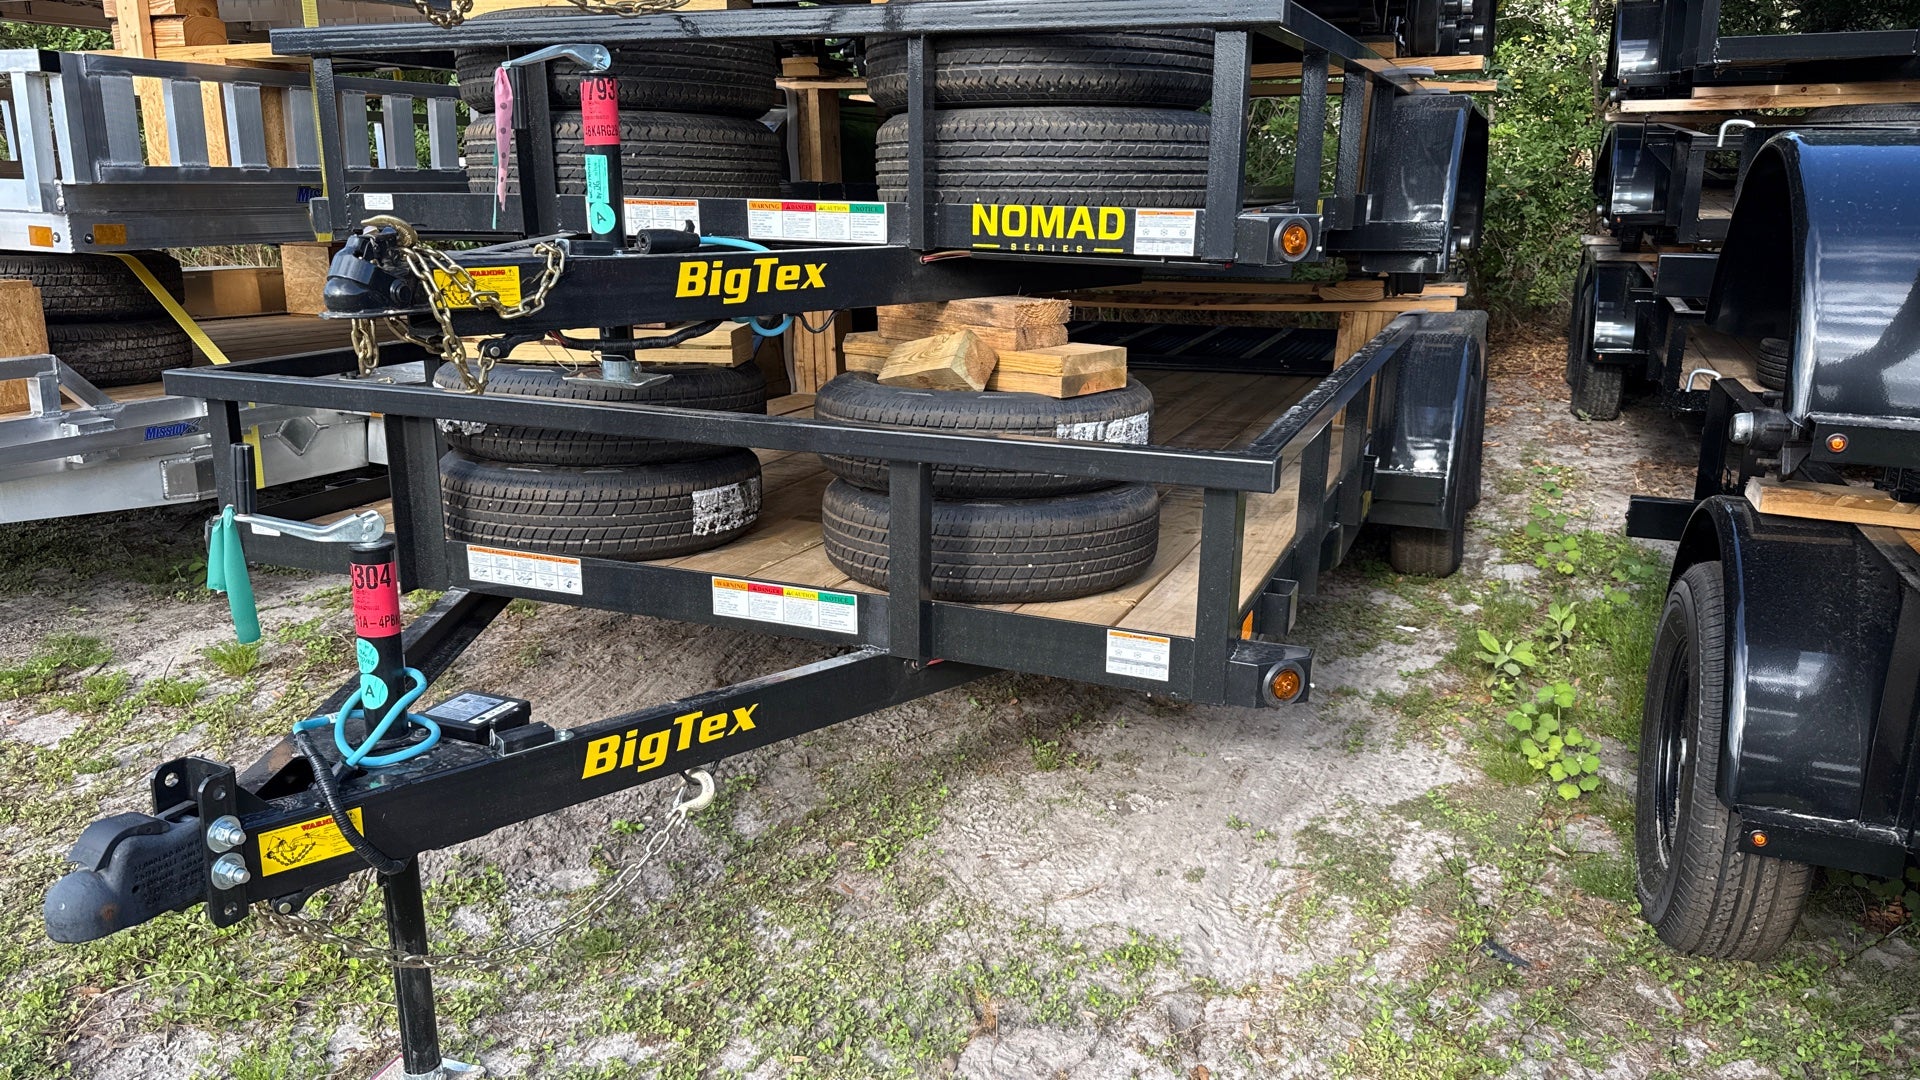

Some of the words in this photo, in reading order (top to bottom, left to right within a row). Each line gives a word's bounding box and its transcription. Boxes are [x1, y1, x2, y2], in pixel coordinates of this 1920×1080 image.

[750, 202, 780, 210] WARNING
[972, 203, 1126, 240] NOMAD
[1010, 243, 1083, 253] SERIES
[675, 257, 828, 305] BigTex
[716, 580, 746, 590] WARNING
[756, 586, 781, 594] DANGER
[790, 590, 816, 599] CAUTION
[823, 595, 849, 604] NOTICE
[364, 684, 376, 698] A
[581, 703, 760, 780] BigTex
